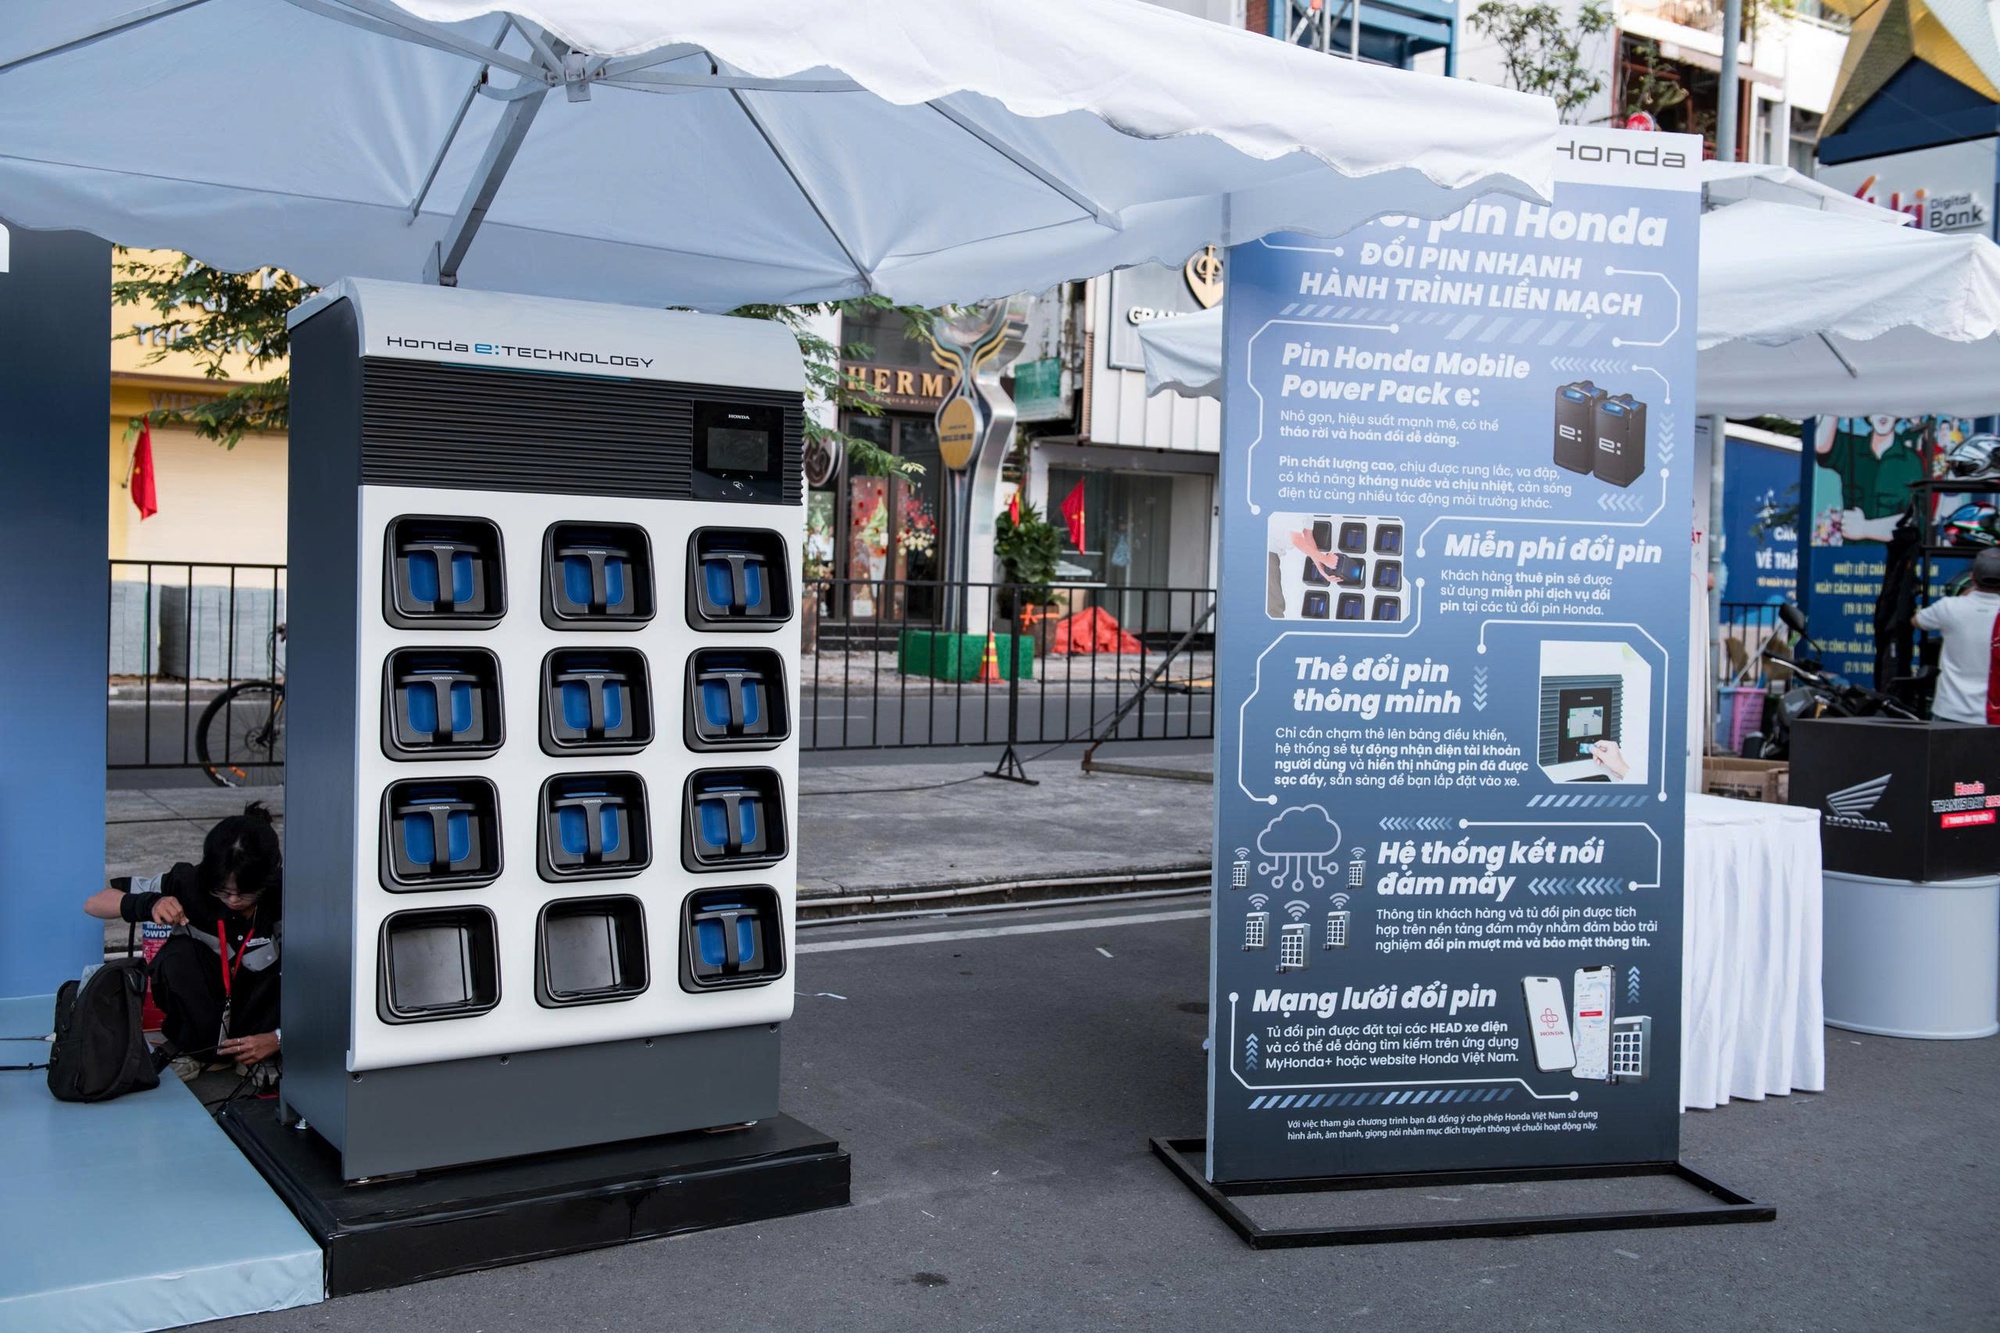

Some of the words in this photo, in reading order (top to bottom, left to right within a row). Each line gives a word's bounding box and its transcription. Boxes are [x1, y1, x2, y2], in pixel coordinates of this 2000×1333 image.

[1931, 194, 1971, 209] Digital
[1514, 200, 1667, 246] Honda
[1931, 205, 1982, 228] Bank
[1360, 235, 1415, 267] ĐỔI
[1419, 246, 1470, 271] PIN
[1474, 251, 1582, 279] NHANH
[1299, 268, 1389, 299] HÀNH
[1395, 274, 1484, 305] TRÌNH
[1488, 278, 1550, 310] LIỀN
[1554, 289, 1642, 319] MẠCH
[387, 336, 468, 353] Honda
[1282, 342, 1329, 367] Pin
[1334, 346, 1430, 373] Honda
[1434, 351, 1530, 378] Mobile
[1281, 374, 1375, 400] Power
[1378, 379, 1451, 405] Pack
[1454, 387, 1480, 406] e:
[1280, 409, 1305, 421] Nhỏ
[1308, 413, 1334, 425] gọn,
[1338, 412, 1364, 426] hiệu
[1368, 413, 1394, 425] suất
[1398, 417, 1433, 429] mạnh
[1461, 419, 1476, 429] có
[1480, 419, 1498, 431] thể
[1560, 424, 1582, 442] e:
[1599, 438, 1621, 455] e:
[1444, 530, 1514, 558] Miễn
[1517, 536, 1566, 566] phí
[1570, 534, 1614, 561] đổi
[1616, 539, 1662, 569] pin
[1441, 569, 1478, 581] Khách
[1482, 570, 1513, 586] hàng
[1515, 571, 1543, 582] thuê
[1545, 572, 1564, 586] pin
[1567, 573, 1580, 584] sẽ
[1583, 574, 1612, 587] được
[1440, 600, 1459, 614] pin
[1462, 600, 1478, 614] tại
[1480, 601, 1502, 612] các
[1506, 601, 1517, 612] tủ
[1520, 601, 1538, 613] đổi
[1542, 602, 1560, 616] pin
[1563, 604, 1603, 615] Honda.
[1295, 655, 1348, 680] Thẻ
[1352, 654, 1399, 681] đổi
[1401, 657, 1449, 689] pin
[1293, 687, 1381, 720] thông
[1384, 688, 1461, 713] minh
[1276, 726, 1296, 738] Chỉ
[1326, 728, 1361, 741] chạm
[1365, 727, 1384, 739] thẻ
[1388, 728, 1405, 739] lên
[1409, 728, 1440, 743] bảng
[1444, 728, 1469, 740] điều
[1826, 815, 1892, 833] HONDA
[1377, 840, 1416, 870] Hệ
[1421, 836, 1505, 874] thống
[1509, 836, 1556, 863] kết
[1559, 836, 1604, 863] nối
[1377, 870, 1444, 894] đám
[1448, 870, 1516, 901] mây
[1376, 939, 1421, 953] nghiệm
[1424, 937, 1444, 949] đổi
[1446, 938, 1465, 952] pin
[1468, 938, 1500, 951] mượt
[1503, 937, 1522, 948] mà
[1525, 937, 1540, 948] và
[1543, 936, 1566, 947] bảo
[1568, 936, 1592, 950] mật
[1594, 936, 1629, 950] thông
[1631, 936, 1650, 946] tin.
[1252, 989, 1338, 1018] Mạng
[1341, 984, 1397, 1009] lưới
[1401, 980, 1447, 1008] đổi
[1449, 983, 1496, 1015] pin
[1266, 1025, 1280, 1037] Tủ
[1284, 1024, 1303, 1036] đổi
[1306, 1025, 1325, 1039] pin
[1328, 1025, 1359, 1038] được
[1362, 1024, 1383, 1037] đặt
[1386, 1023, 1402, 1036] tại
[1405, 1022, 1427, 1033] các
[1430, 1022, 1462, 1033] HEAD
[1464, 1024, 1479, 1032] xe
[1481, 1021, 1507, 1034] điện
[1266, 1056, 1332, 1071] MyHonda+
[1336, 1055, 1366, 1068] hoặc
[1370, 1054, 1416, 1065] website
[1419, 1052, 1458, 1064] Honda
[1462, 1052, 1484, 1065] Việt
[1488, 1052, 1518, 1062] Nam.
